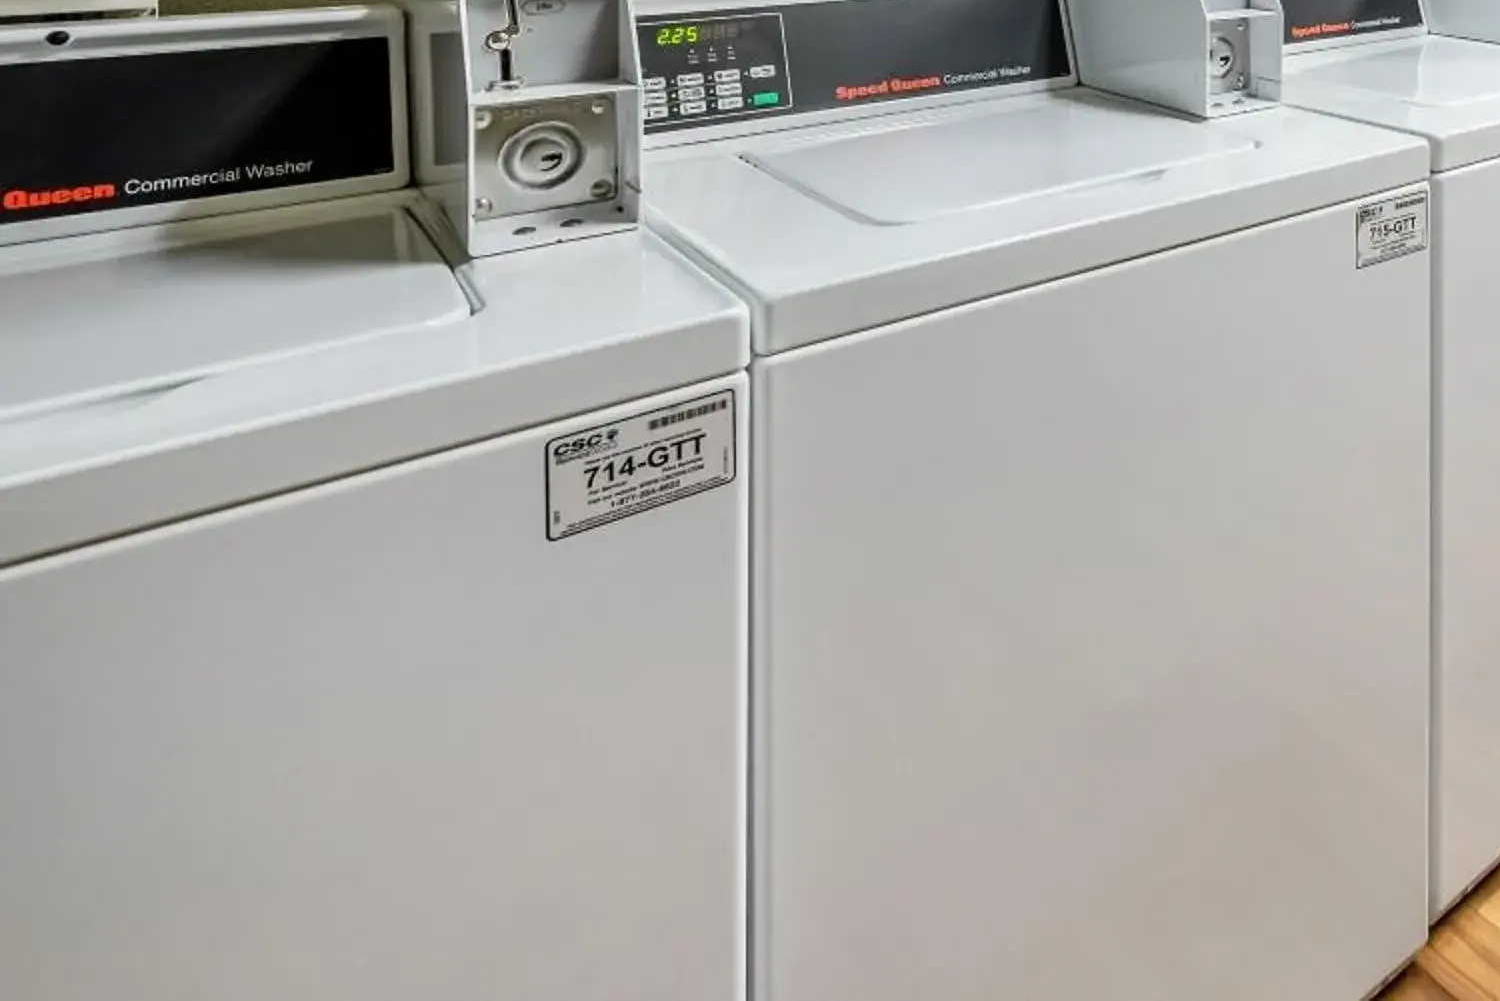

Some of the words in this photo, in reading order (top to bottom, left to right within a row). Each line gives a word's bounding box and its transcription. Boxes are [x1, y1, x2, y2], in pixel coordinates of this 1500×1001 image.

[656, 25, 698, 45] 2.25
[834, 80, 889, 100] Speed
[889, 74, 941, 92] Queen
[2, 181, 116, 210] Queen
[124, 167, 241, 195] Commercial
[245, 159, 314, 180] Washer
[553, 432, 602, 459] CSC
[583, 432, 707, 490] 714-GTT
